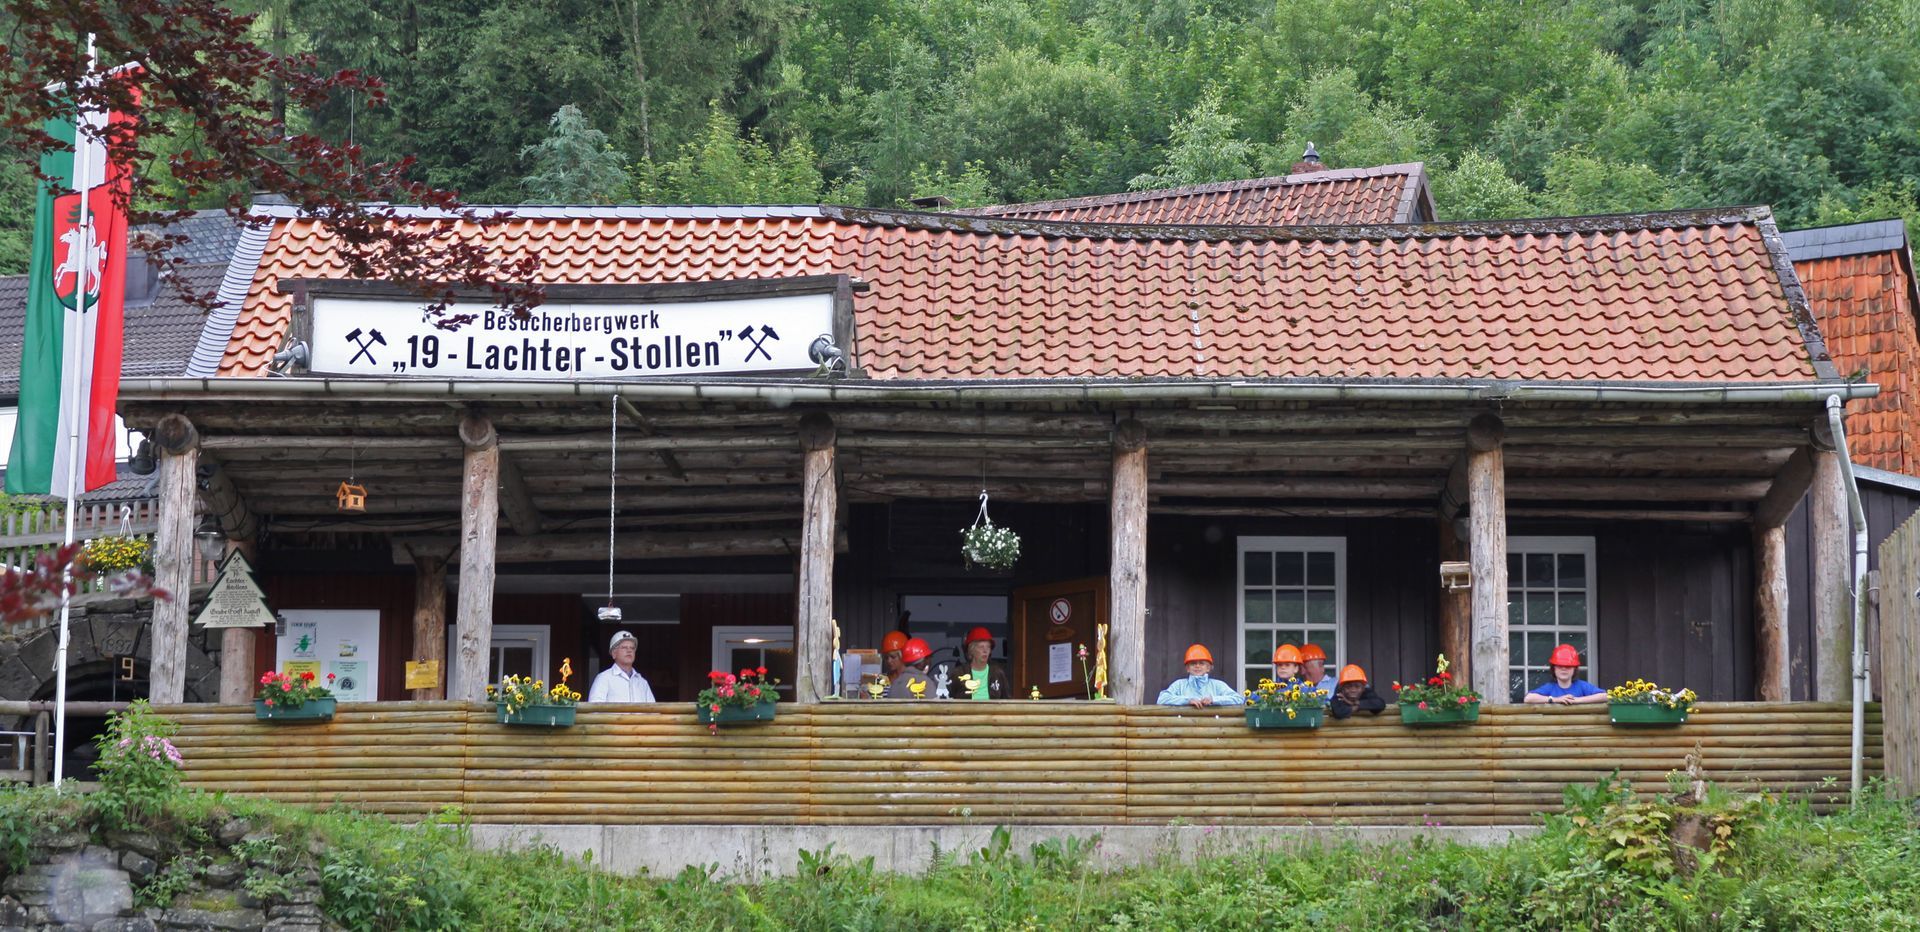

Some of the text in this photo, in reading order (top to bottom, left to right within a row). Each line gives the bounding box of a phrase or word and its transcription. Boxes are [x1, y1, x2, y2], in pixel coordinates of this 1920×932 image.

[484, 310, 660, 334] Besucherbergwerk
[466, 336, 587, 372] Lachter
[121, 657, 134, 681] 9
